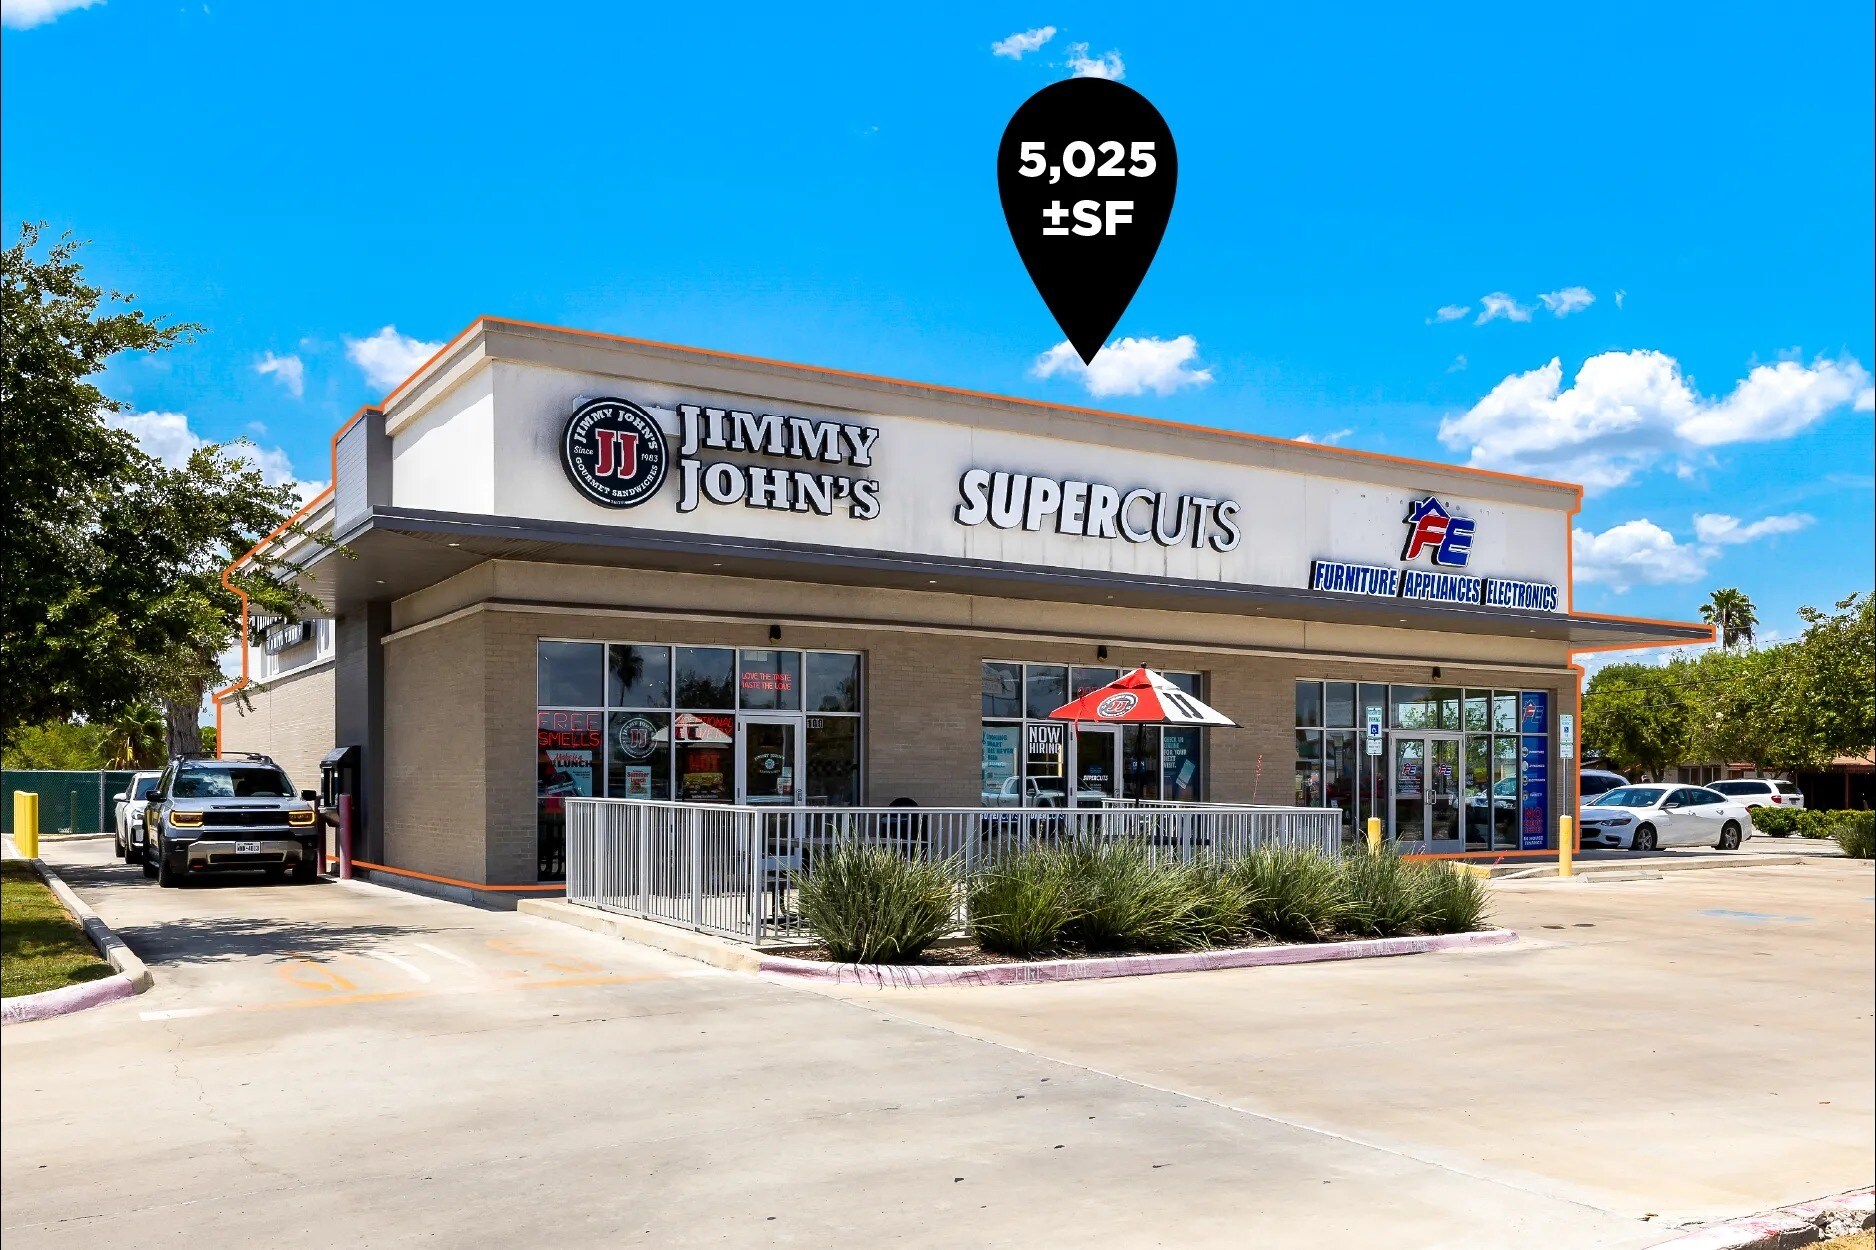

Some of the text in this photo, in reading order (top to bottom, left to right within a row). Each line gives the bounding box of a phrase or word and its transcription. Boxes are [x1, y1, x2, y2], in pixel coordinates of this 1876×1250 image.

[574, 408, 659, 451] JIMMY JOHN'S
[677, 403, 880, 467] JIMMY
[573, 445, 659, 463] Since 1983
[595, 427, 640, 480] JJ
[575, 456, 659, 498] GOURMET SANDWICHES
[677, 459, 882, 521] JOHN'S
[954, 468, 1243, 553] SUPERCUTS
[1312, 562, 1559, 613] FURNITURE APPLIANCES ELECTRONICS
[742, 672, 792, 682] LOVE THE TASTE
[742, 680, 792, 690] TASTE THE LOVE
[537, 712, 600, 732] FREE
[538, 732, 600, 747] SMELLS
[1029, 726, 1060, 743] NOW
[1029, 742, 1061, 754] HIRING
[1524, 807, 1543, 820] NO
